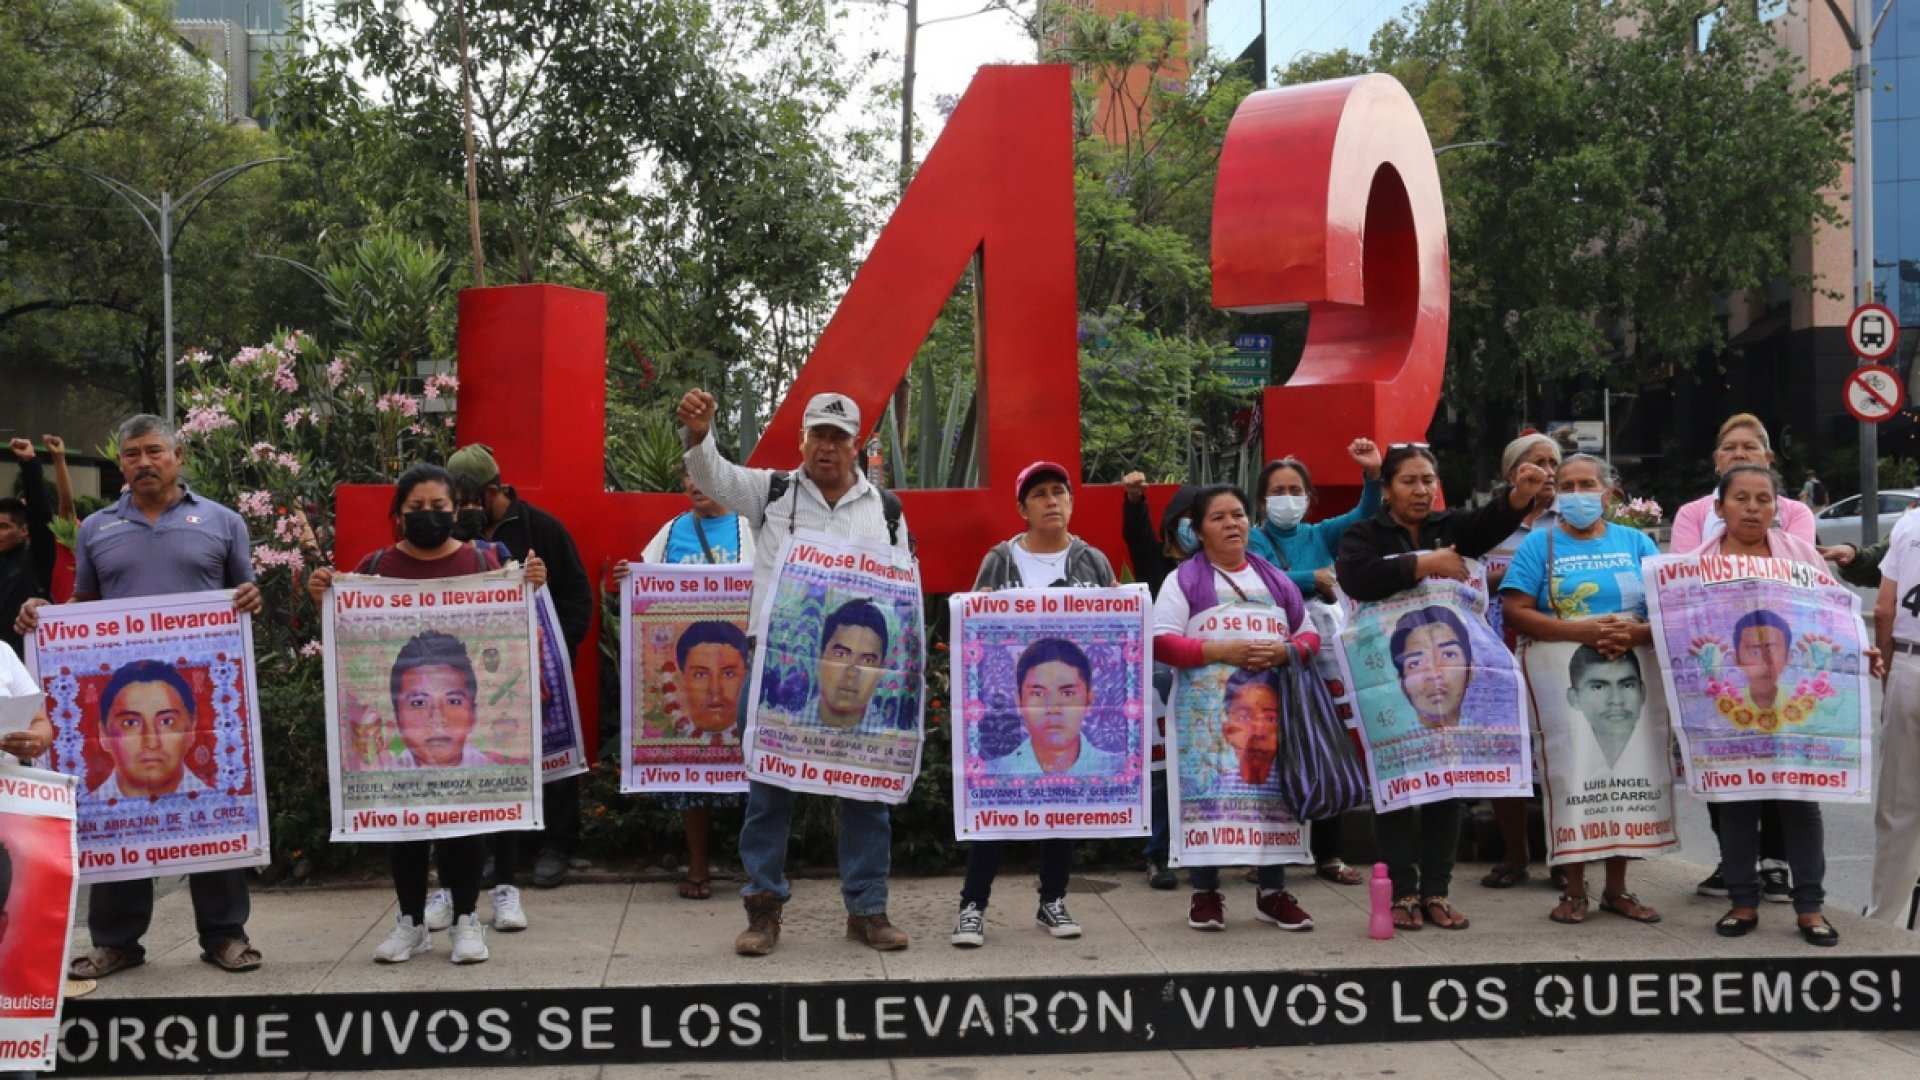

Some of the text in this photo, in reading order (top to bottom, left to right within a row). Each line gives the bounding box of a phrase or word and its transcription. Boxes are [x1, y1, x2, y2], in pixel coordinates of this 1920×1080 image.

[1659, 562, 1700, 585] ¡Viv
[1699, 553, 1733, 582] NOS
[634, 576, 675, 596] ¡Vivo
[680, 580, 699, 592] se
[704, 576, 718, 591] lo
[337, 585, 523, 614] ¡Vivo se lo llevaron!
[965, 594, 1140, 618] ¡Vivo se lo llevaron!
[39, 621, 89, 647] ¡Vivo
[96, 621, 120, 637] se
[126, 615, 144, 634] lo
[151, 609, 238, 631] llevaron!
[1224, 616, 1241, 631] se
[1247, 615, 1262, 631] lo
[641, 768, 680, 786] ¡Vivo
[685, 768, 700, 782] lo
[759, 754, 906, 792] ¡Vivo lo queremos!
[1702, 771, 1742, 791] ¡Vivo
[1748, 768, 1766, 785] lo
[1388, 777, 1422, 800] ¡Vivo
[1425, 772, 1440, 787] lo
[1584, 780, 1607, 791] LUIS
[166, 812, 182, 825] DE
[190, 810, 205, 822] LA
[213, 807, 245, 819] CRUZ
[353, 804, 522, 832] ¡Vivo lo queremos!
[975, 808, 1133, 832] ¡Vivo lo queremos!
[1185, 828, 1209, 849] ¡Con
[1212, 827, 1245, 845] VIDA
[1249, 828, 1262, 845] lo
[1580, 821, 1608, 840] VIDA
[1609, 820, 1620, 837] lo
[121, 847, 139, 865] lo
[146, 834, 248, 865] queremos!
[315, 1008, 512, 1056] VIVOS
[537, 1006, 615, 1051] SE
[641, 1002, 762, 1048] LOS
[798, 989, 1155, 1042] LLEVARON,
[1180, 981, 1367, 1029] VIVOS
[1393, 977, 1508, 1023] LOS
[1534, 968, 1902, 1020] QUEREMOS!
